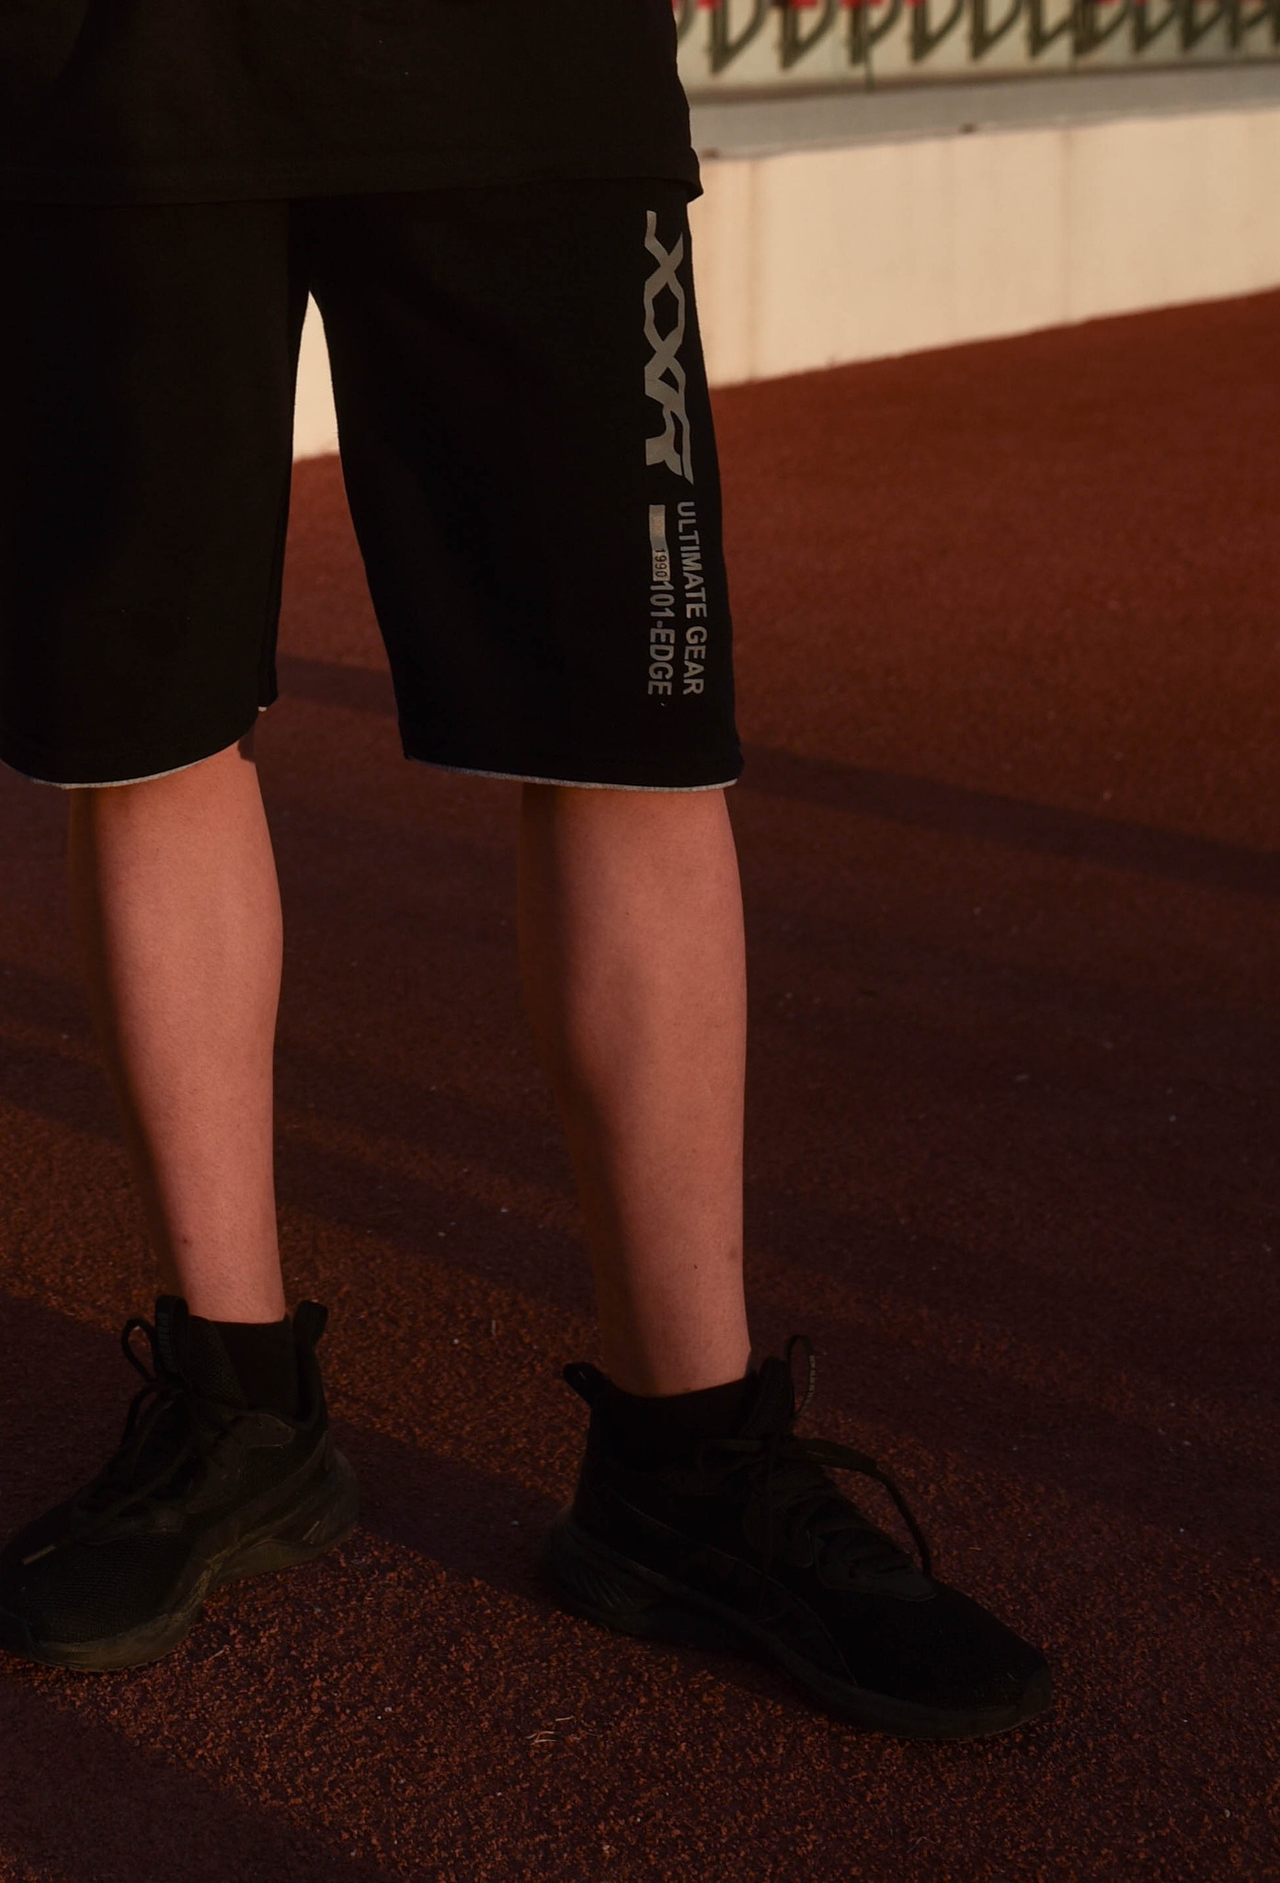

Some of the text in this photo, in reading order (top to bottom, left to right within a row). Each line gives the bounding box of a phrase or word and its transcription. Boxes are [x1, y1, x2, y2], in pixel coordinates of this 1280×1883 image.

[647, 581, 675, 696] 101-EDGE
[677, 501, 708, 696] ULTIMATE GEAR
